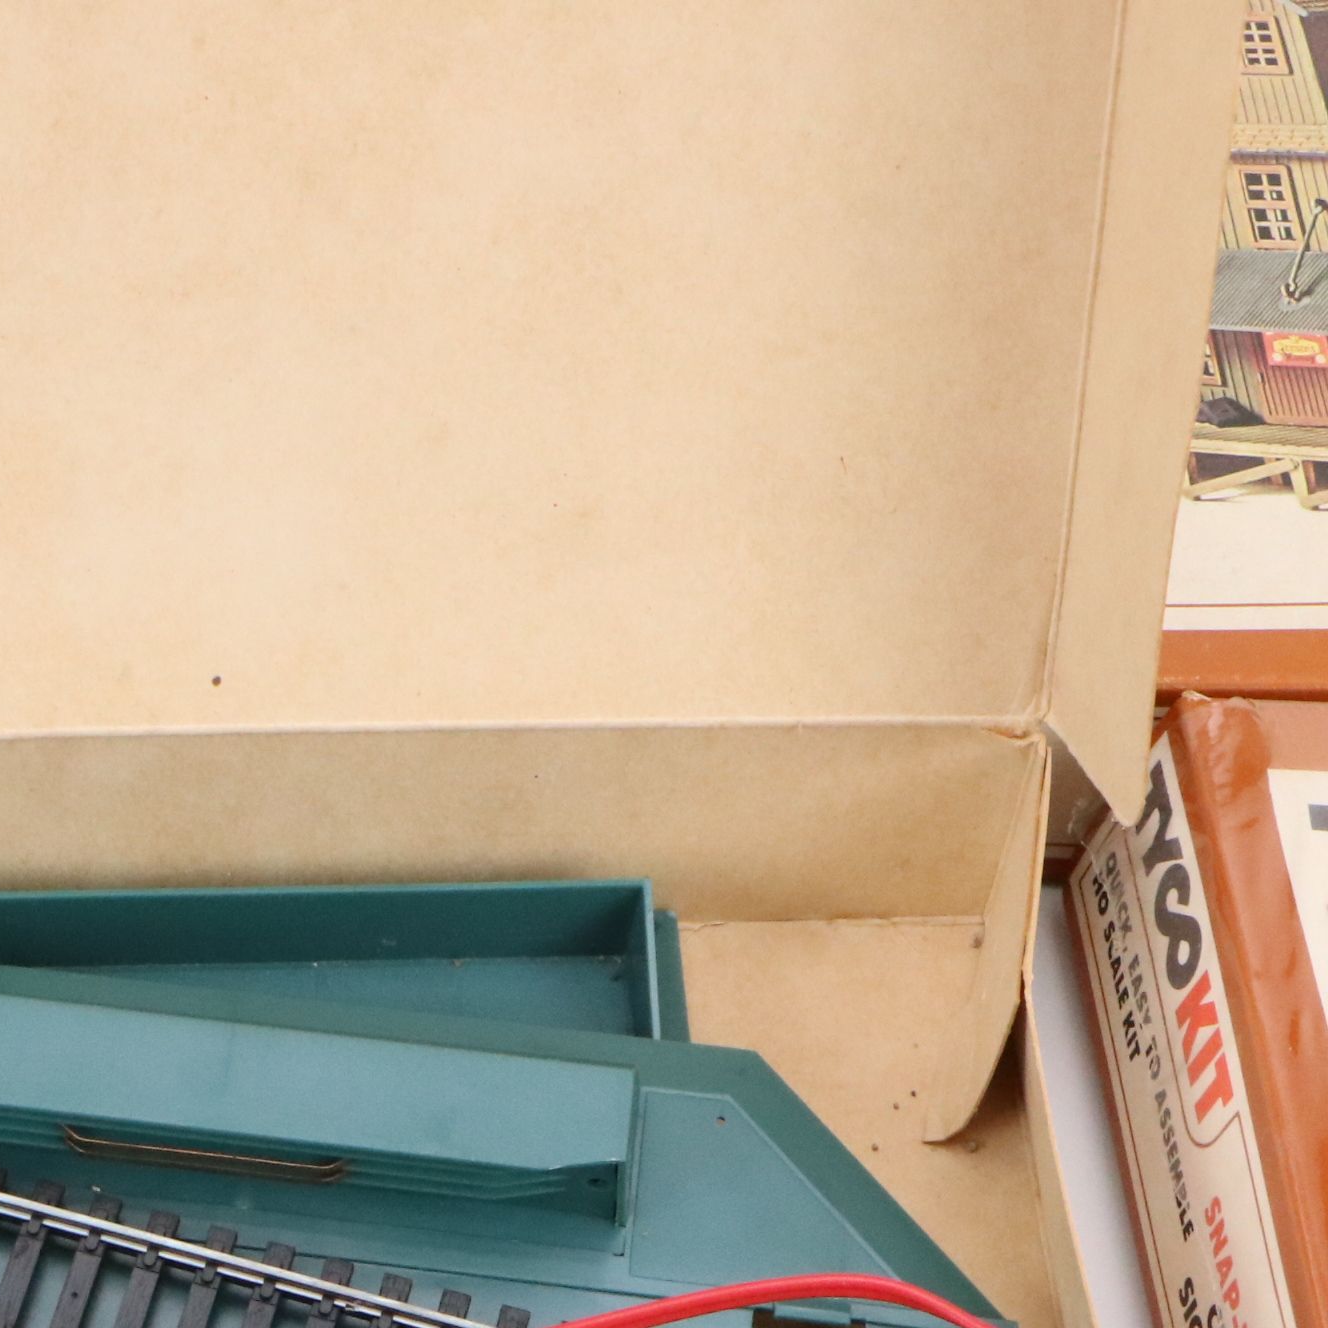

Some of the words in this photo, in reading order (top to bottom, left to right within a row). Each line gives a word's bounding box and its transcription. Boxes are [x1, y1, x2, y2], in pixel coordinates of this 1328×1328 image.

[1092, 875, 1109, 916] HO
[1103, 919, 1129, 1010] SCALE
[1123, 1009, 1141, 1062] KIT
[1154, 1088, 1195, 1242] ASSEMBLE
